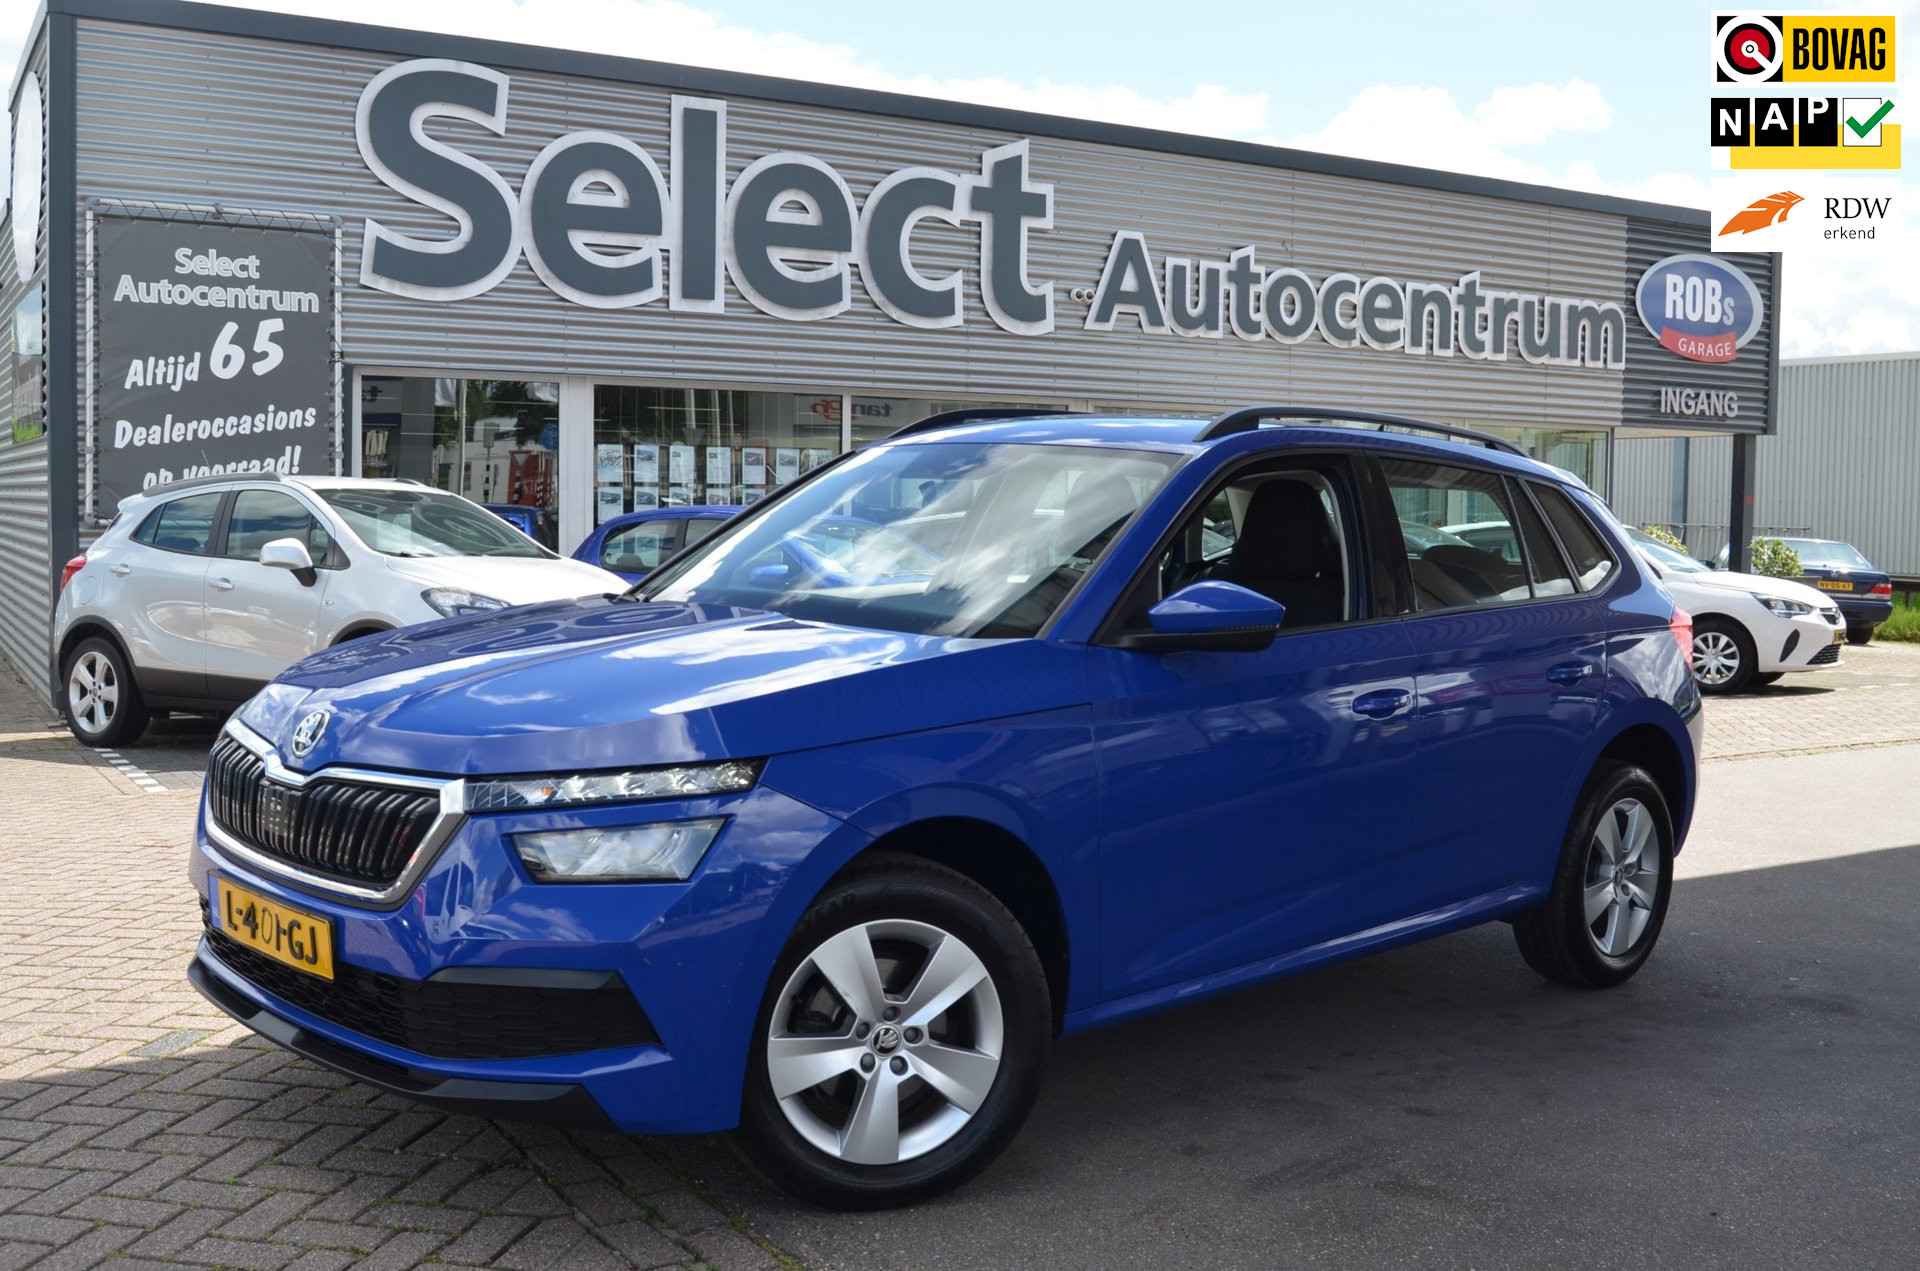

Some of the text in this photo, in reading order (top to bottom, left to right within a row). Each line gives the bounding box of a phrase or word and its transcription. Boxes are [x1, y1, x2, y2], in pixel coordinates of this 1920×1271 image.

[355, 58, 1054, 335] Select
[174, 247, 260, 279] Select
[113, 274, 320, 313] Autocentrum
[1084, 230, 1626, 369] Autocentrum
[1665, 273, 1735, 326] ROBs
[124, 318, 285, 392] Altijd 65
[1678, 337, 1732, 357] GARAGE
[114, 404, 317, 449] Dealeroccasions
[1660, 386, 1738, 418] INGANG
[226, 890, 318, 965] L-401-GJ
